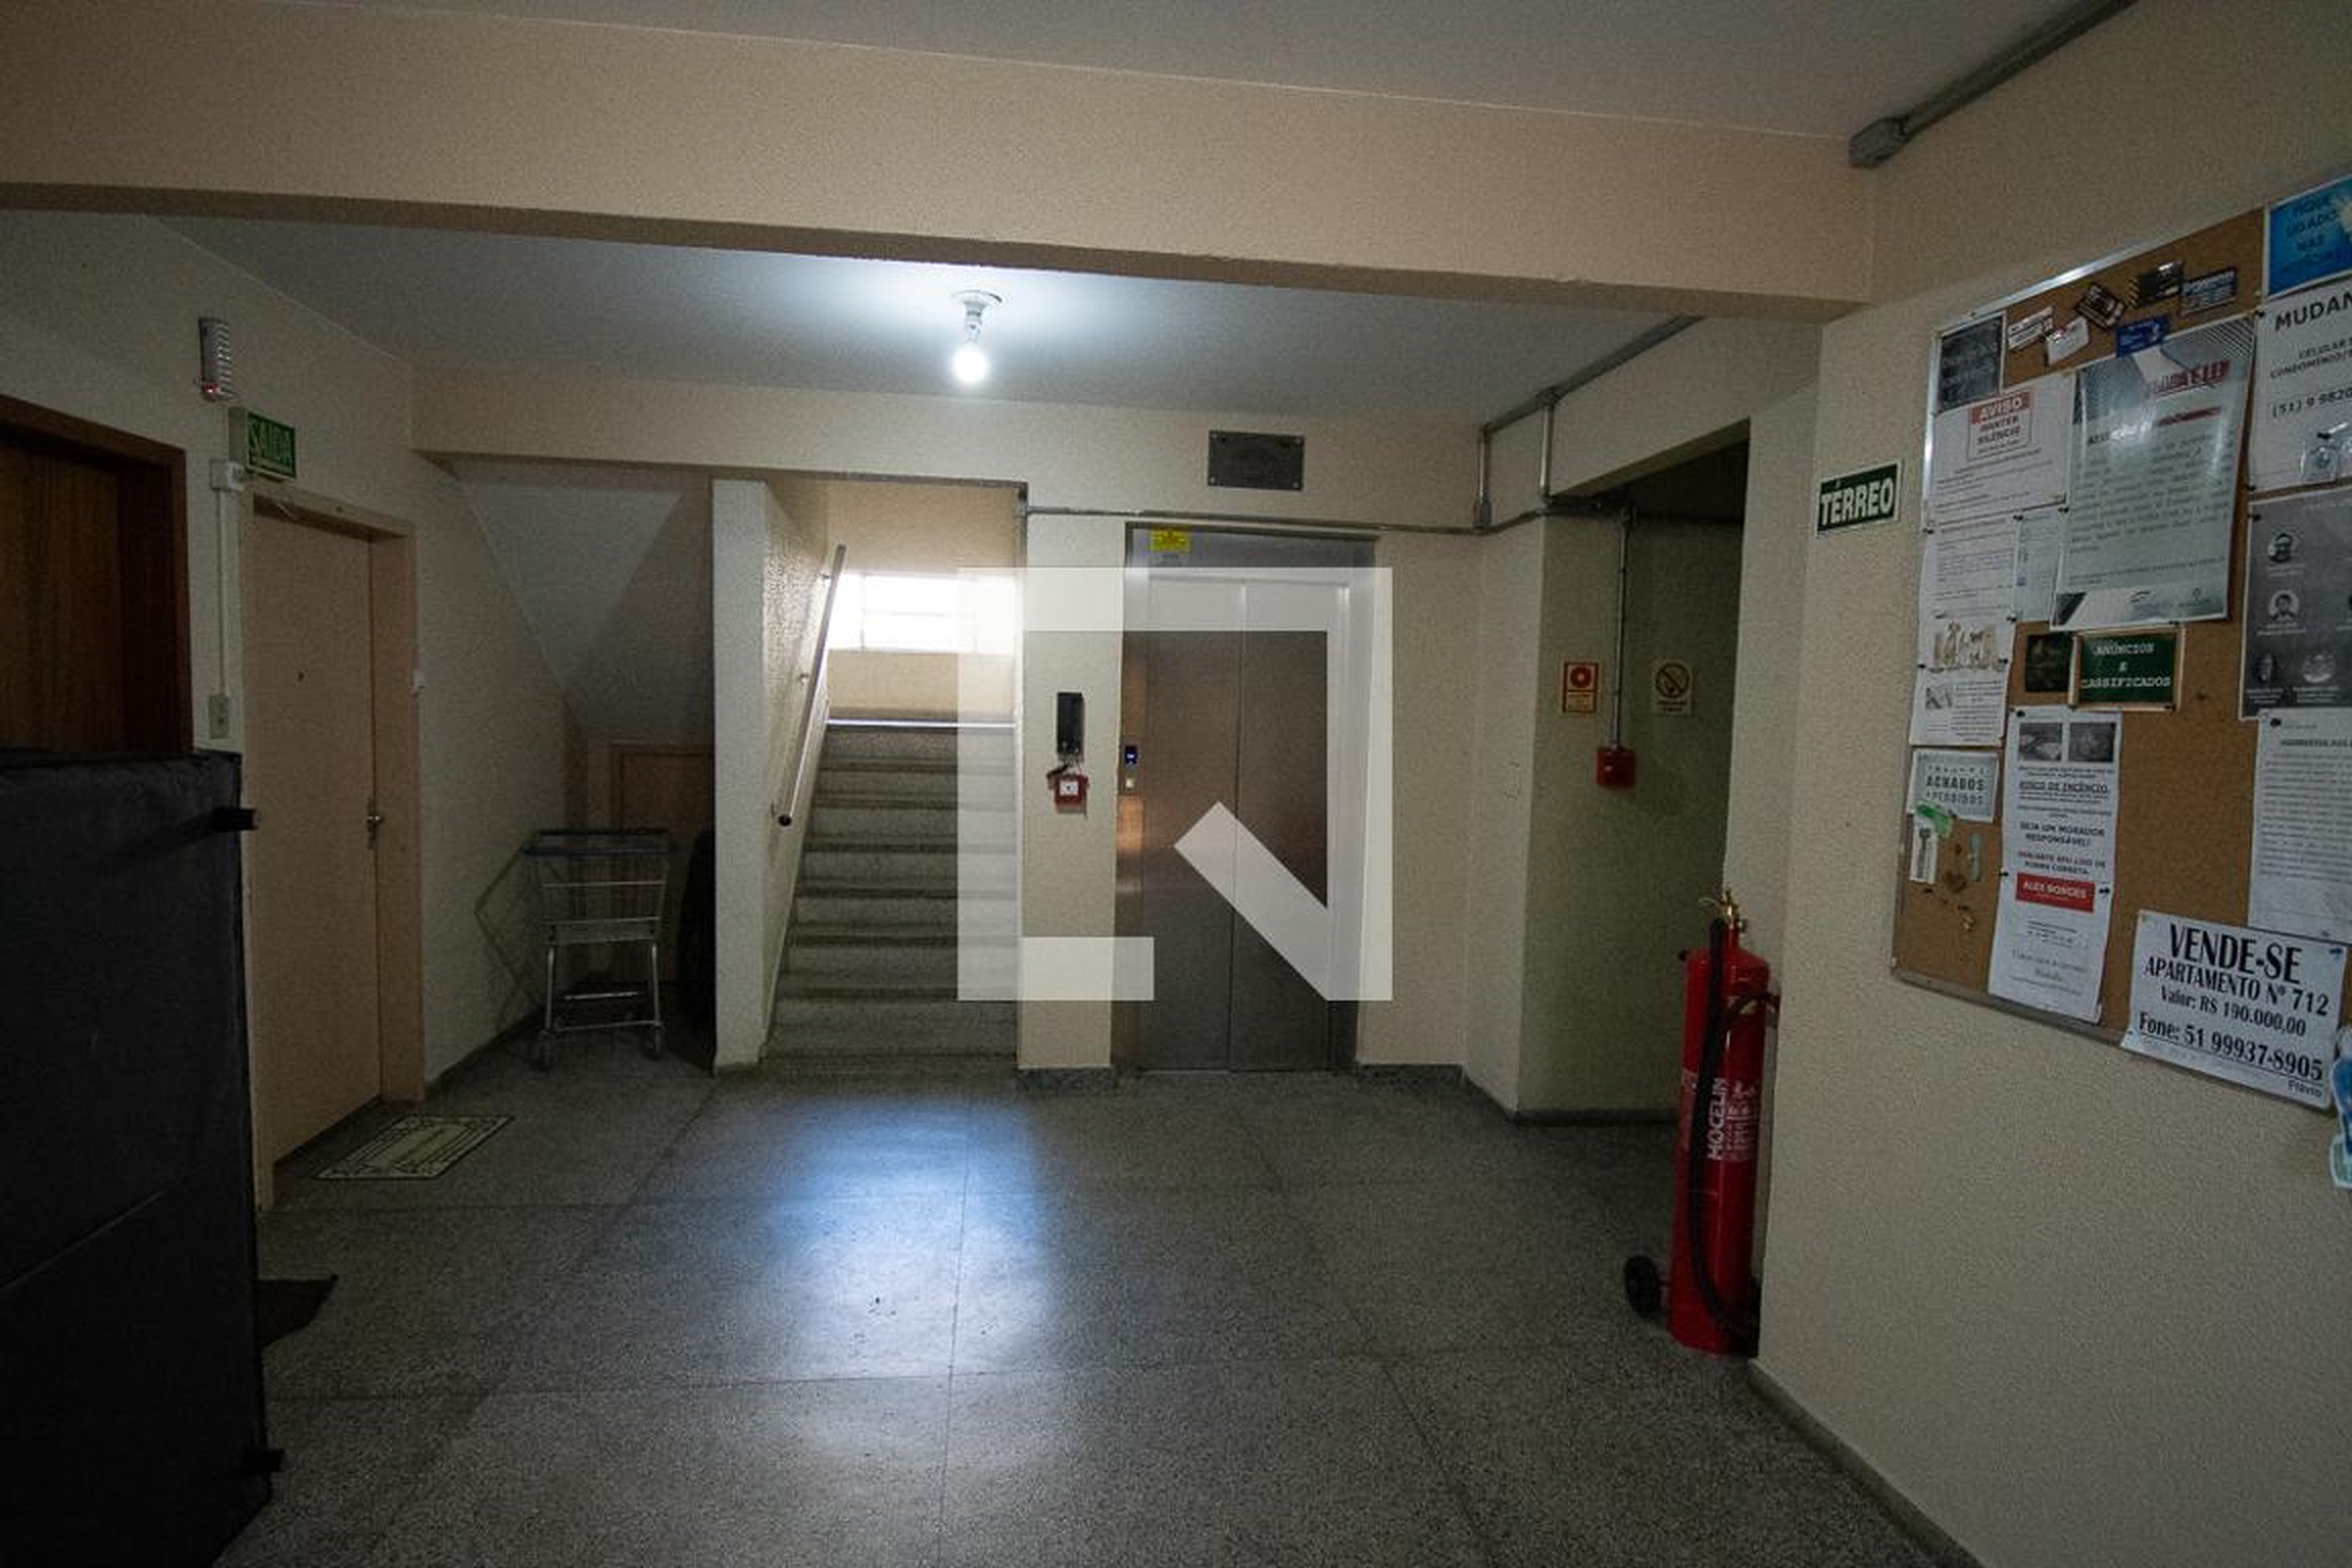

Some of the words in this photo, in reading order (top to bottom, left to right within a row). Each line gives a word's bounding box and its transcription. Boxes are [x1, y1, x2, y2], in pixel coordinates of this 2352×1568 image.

[1979, 397, 2022, 419] AVISO
[1927, 775, 1984, 791] ACHADOS
[2170, 923, 2302, 984] VENDE-SE
[2145, 956, 2260, 1001] APARTAMENTO
[2293, 988, 2329, 1016] 712
[2162, 985, 2196, 1009] Valor:
[2223, 1001, 2307, 1038] 190.000,00
[2139, 1012, 2179, 1040] Fone:
[2185, 1025, 2204, 1047] 51
[2211, 1031, 2323, 1081] 99937-8905
